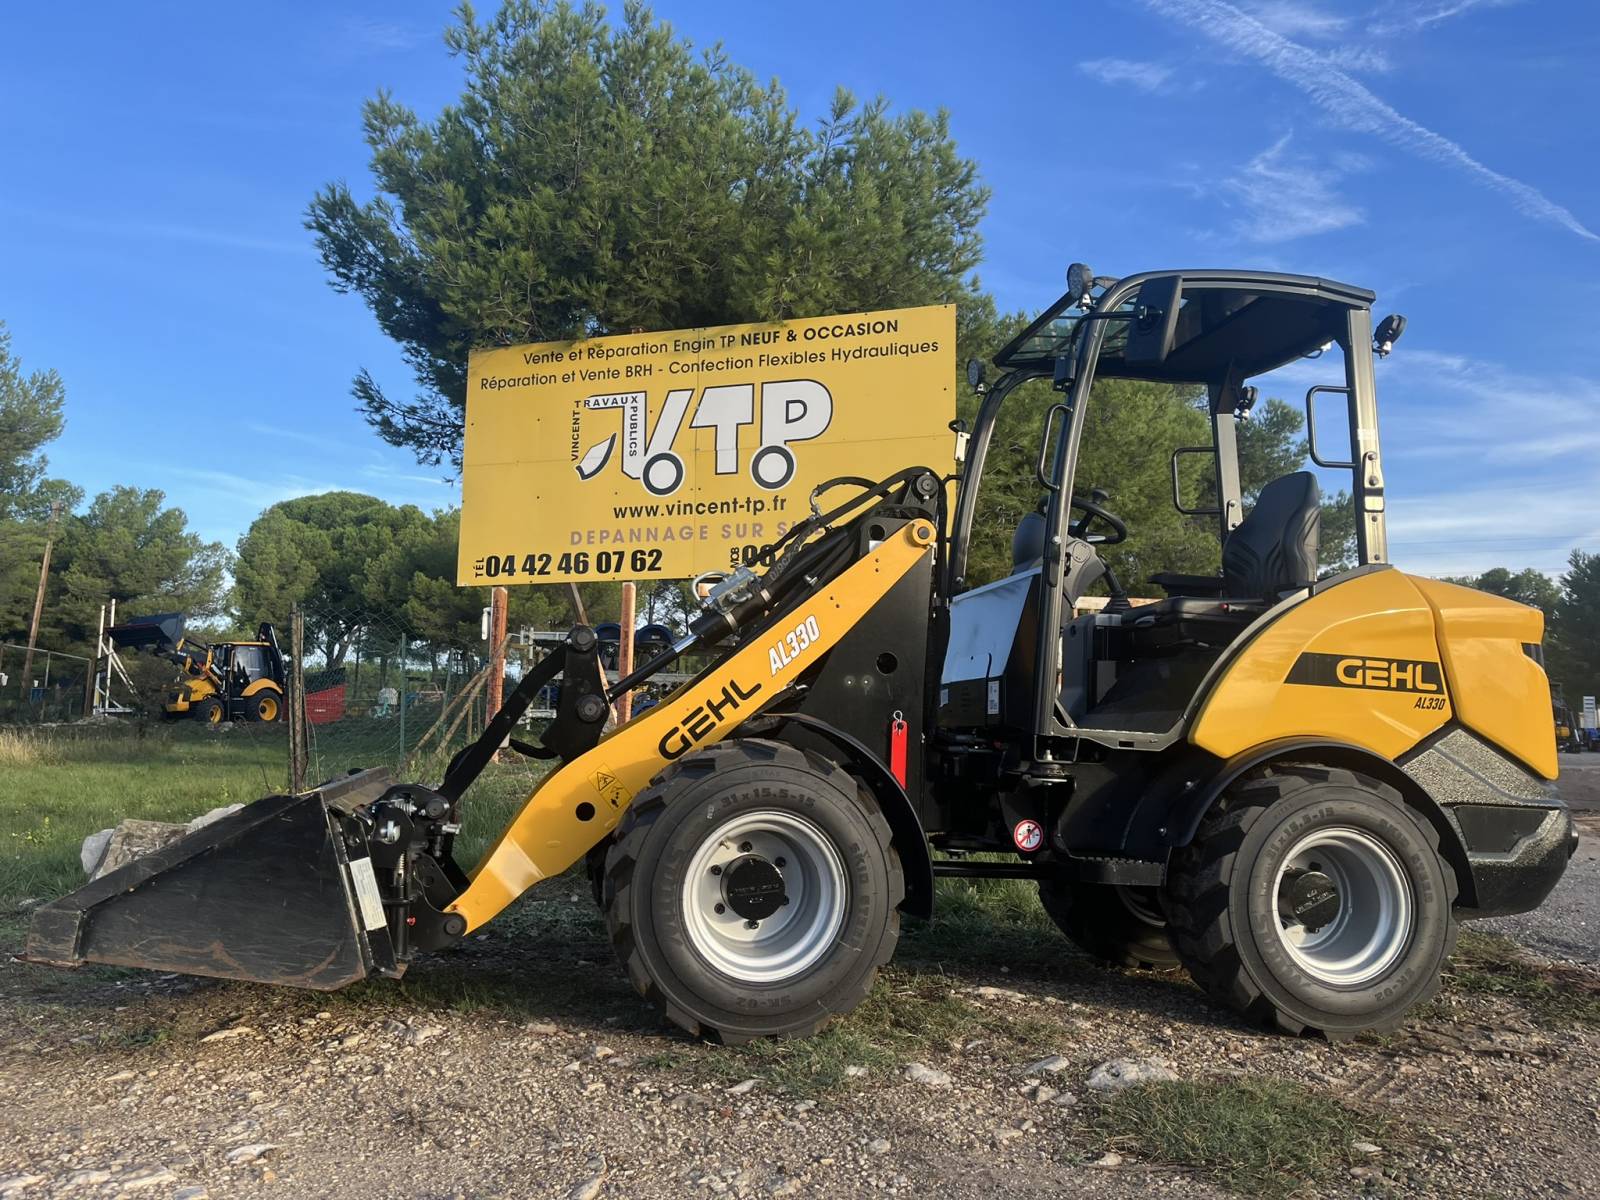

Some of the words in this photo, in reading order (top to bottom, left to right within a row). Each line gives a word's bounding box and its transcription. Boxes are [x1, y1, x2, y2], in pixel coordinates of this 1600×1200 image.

[523, 350, 564, 366] Vente
[568, 348, 583, 361] et
[587, 341, 669, 361] Réparation
[673, 336, 715, 354] Engin
[719, 334, 736, 349] TP
[740, 330, 780, 346] NEUF
[786, 329, 798, 342] &
[803, 319, 899, 341] OCCASION
[480, 371, 557, 390] Réparation
[561, 370, 576, 384] et
[579, 367, 621, 382] Vente
[625, 363, 653, 378] BRH
[668, 356, 753, 374] Confection
[758, 349, 826, 368] Flexibles
[831, 340, 939, 363] Hydrauliques
[574, 395, 638, 408] TRAVAUX
[571, 410, 581, 461] VINCENT
[629, 406, 638, 457] PUBLICS
[613, 495, 787, 519] www.vincent-tp.fr
[570, 525, 709, 545] DEPANNAGE
[721, 522, 764, 540] SUR
[475, 557, 485, 578] TÉL
[485, 555, 516, 577] 04
[521, 553, 552, 576] 42
[557, 551, 590, 575] 46
[596, 550, 625, 574] 07
[631, 549, 663, 572] 62
[767, 615, 820, 677] AL330
[1336, 659, 1438, 691] GEHL
[1414, 696, 1446, 710] AL330
[658, 679, 762, 760] GEHL
